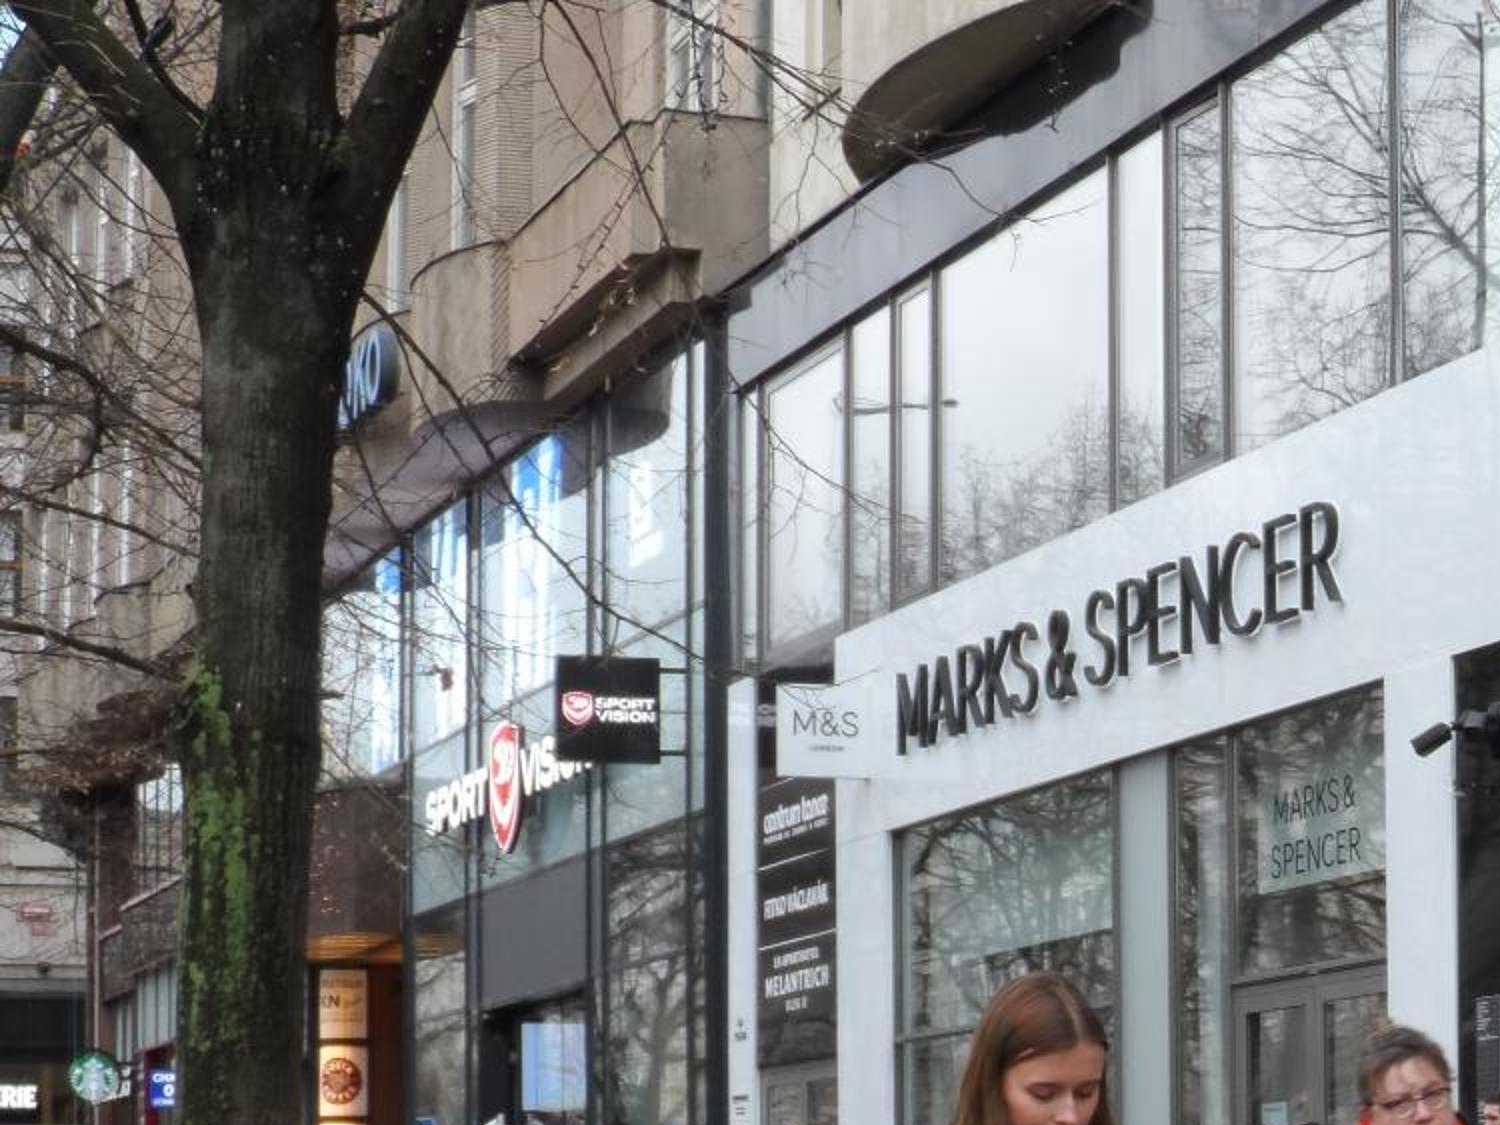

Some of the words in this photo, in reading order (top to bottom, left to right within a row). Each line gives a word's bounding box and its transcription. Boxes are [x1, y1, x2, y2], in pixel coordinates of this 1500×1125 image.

[896, 621, 1039, 756] MARKS
[1083, 501, 1344, 688] SPENCER
[595, 697, 656, 711] SPORT
[596, 710, 657, 724] VISION
[793, 710, 859, 737] M&S
[425, 767, 488, 836] SPORT
[1273, 778, 1340, 828] MARKS
[1271, 827, 1361, 880] SPENCER
